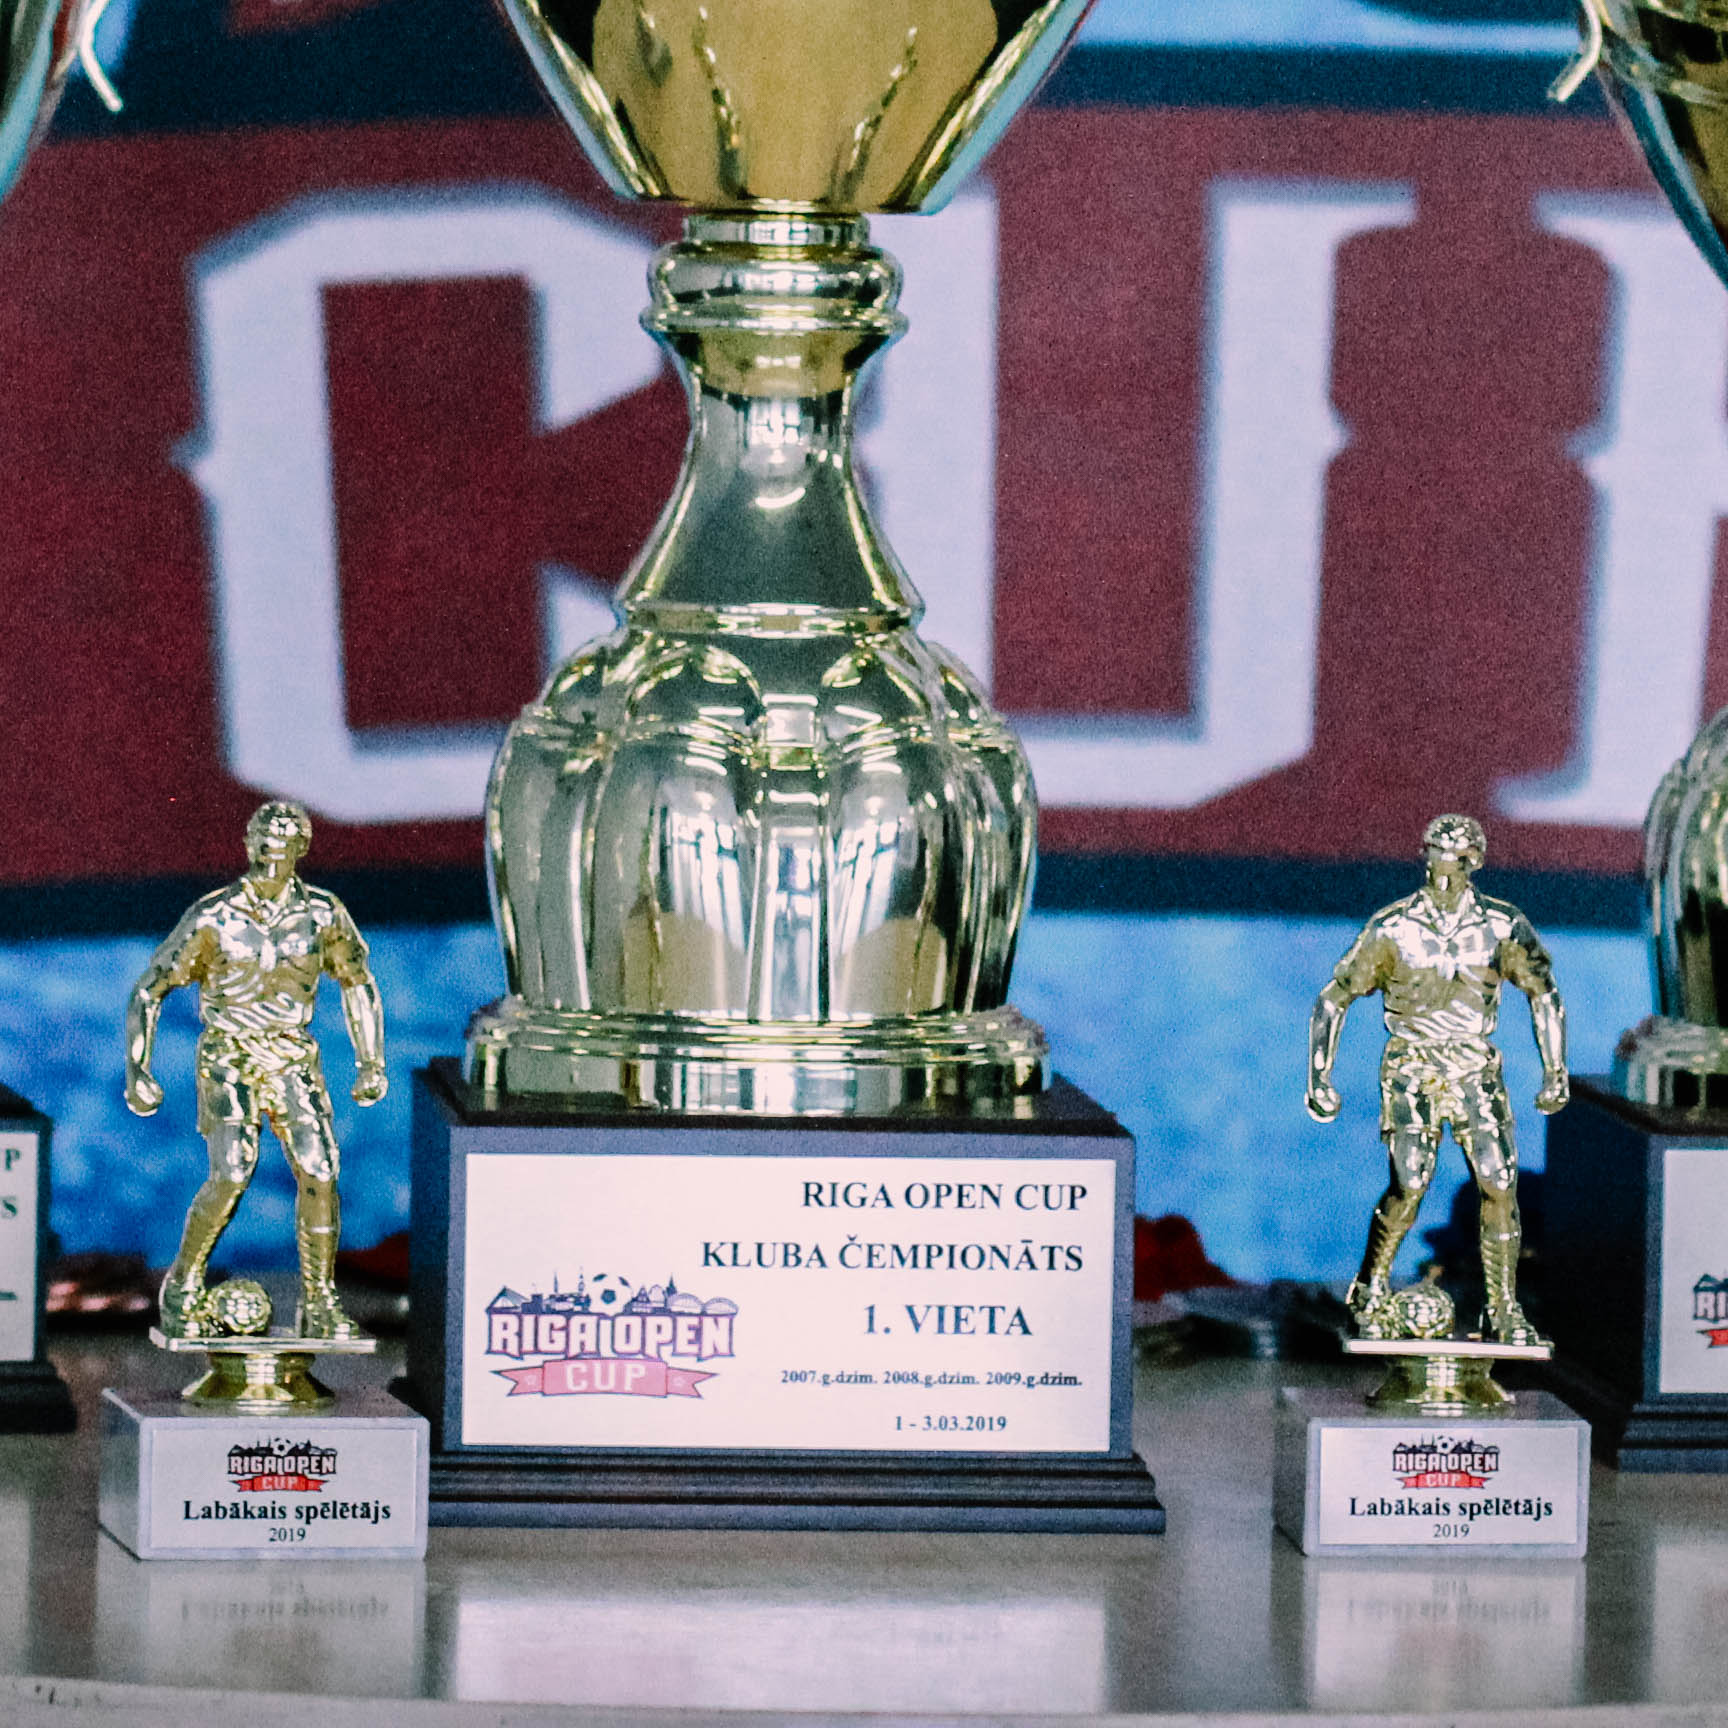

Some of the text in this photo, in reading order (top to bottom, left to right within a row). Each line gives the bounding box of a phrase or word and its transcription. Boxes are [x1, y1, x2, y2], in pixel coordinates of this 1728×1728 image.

[803, 1181, 1088, 1211] RIGA OPEN CUP
[703, 1236, 1083, 1272] KLUBA ČEMPIONĀTS
[864, 1304, 1033, 1336] 1. VIETA
[487, 1313, 735, 1360] RIGA OPEN
[565, 1362, 647, 1391] CUP
[781, 1370, 1083, 1389] 2007.g.dzim. 2008.g.dzim. 2009.g.dzim.
[923, 1415, 1007, 1432] 3.03.2019
[229, 1455, 335, 1475] RIGA OPEN
[1394, 1452, 1498, 1472] RIGA OPEN
[262, 1475, 299, 1490] CUP
[1425, 1473, 1462, 1487] CUP
[183, 1499, 391, 1526] Labākais spēlētājs
[1350, 1496, 1553, 1522] Labākais spēlētājs
[268, 1527, 307, 1543] 2019
[1433, 1523, 1470, 1538] 2019
